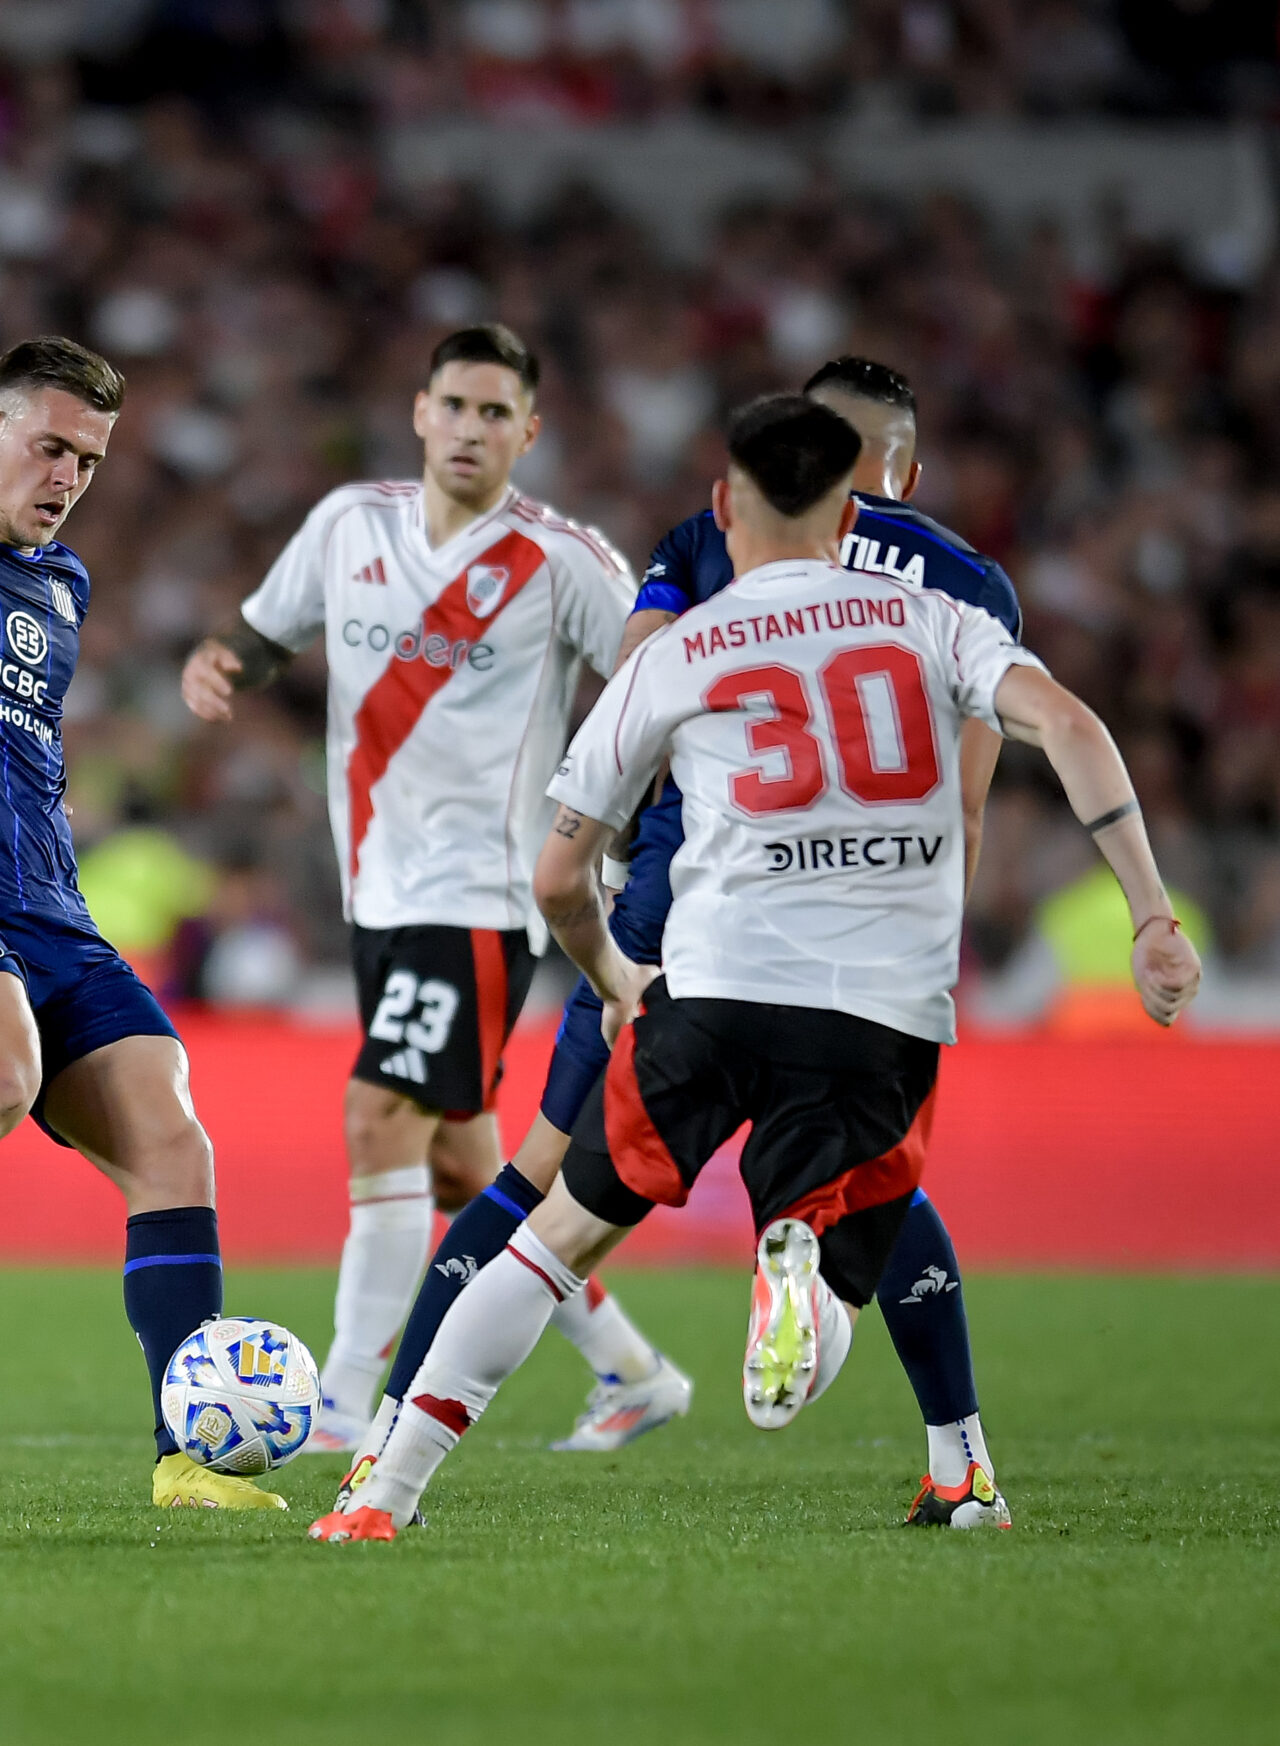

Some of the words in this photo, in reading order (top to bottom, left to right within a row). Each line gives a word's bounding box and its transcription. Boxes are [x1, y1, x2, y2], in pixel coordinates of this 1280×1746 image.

[840, 532, 925, 589] TILLA
[342, 614, 495, 672] codere
[683, 598, 905, 663] MASTANTUONO
[699, 641, 944, 819] 30
[764, 836, 942, 872] DIRECTV
[368, 970, 459, 1054] 23
